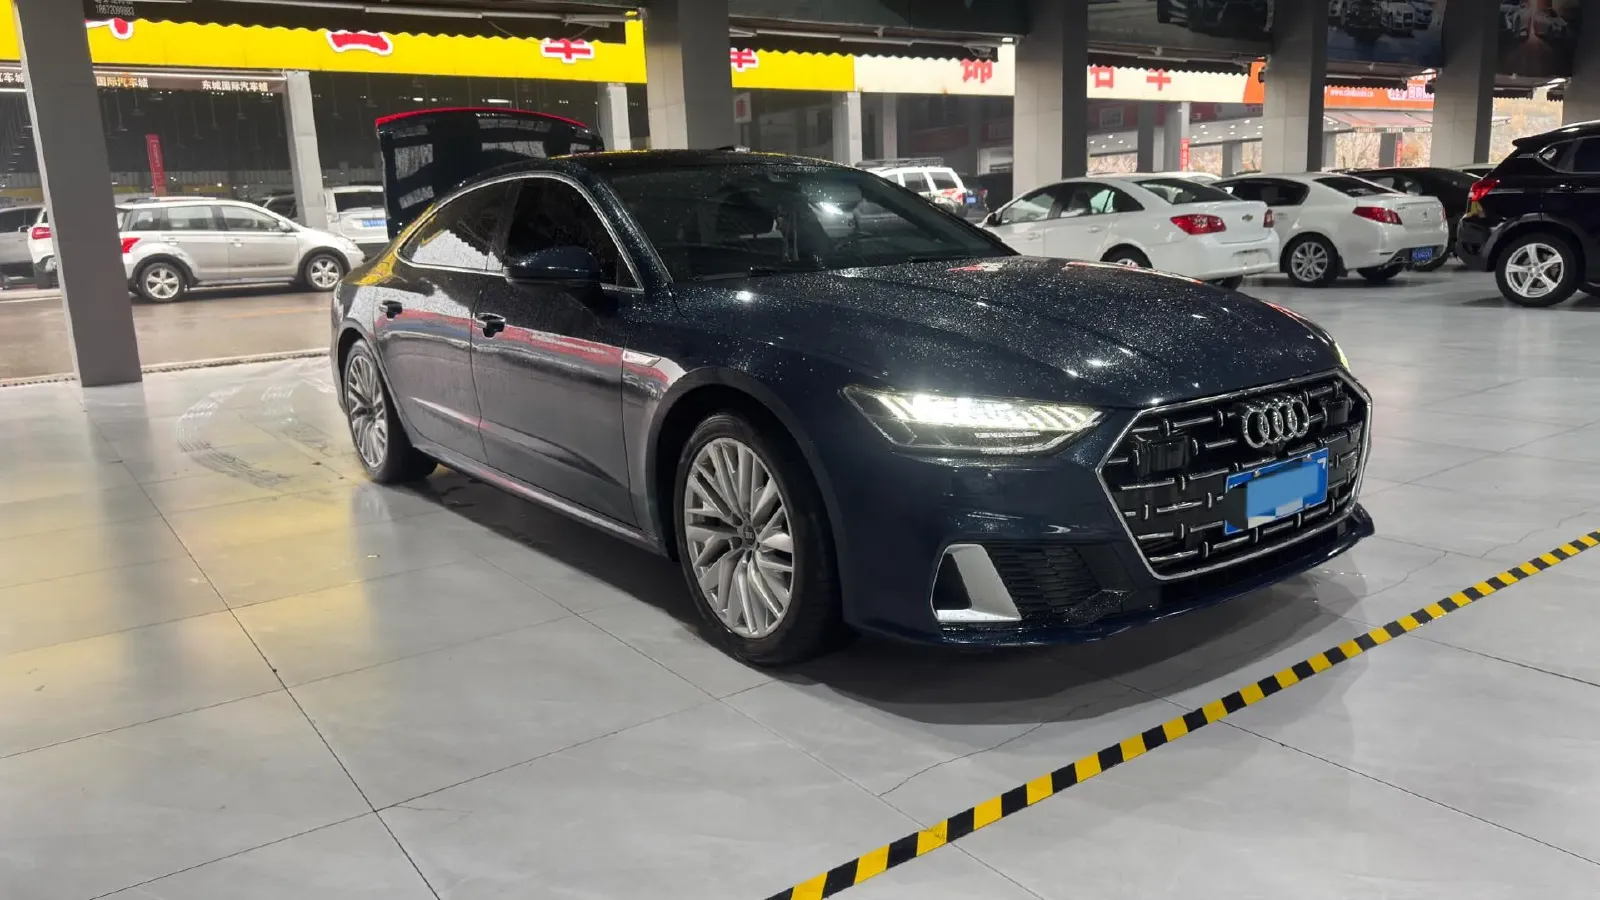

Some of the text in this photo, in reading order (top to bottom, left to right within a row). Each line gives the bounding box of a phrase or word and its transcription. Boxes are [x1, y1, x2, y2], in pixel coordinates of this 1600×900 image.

[96, 76, 149, 88] 国际汽车城
[202, 80, 269, 92] 东城国际汽车城
